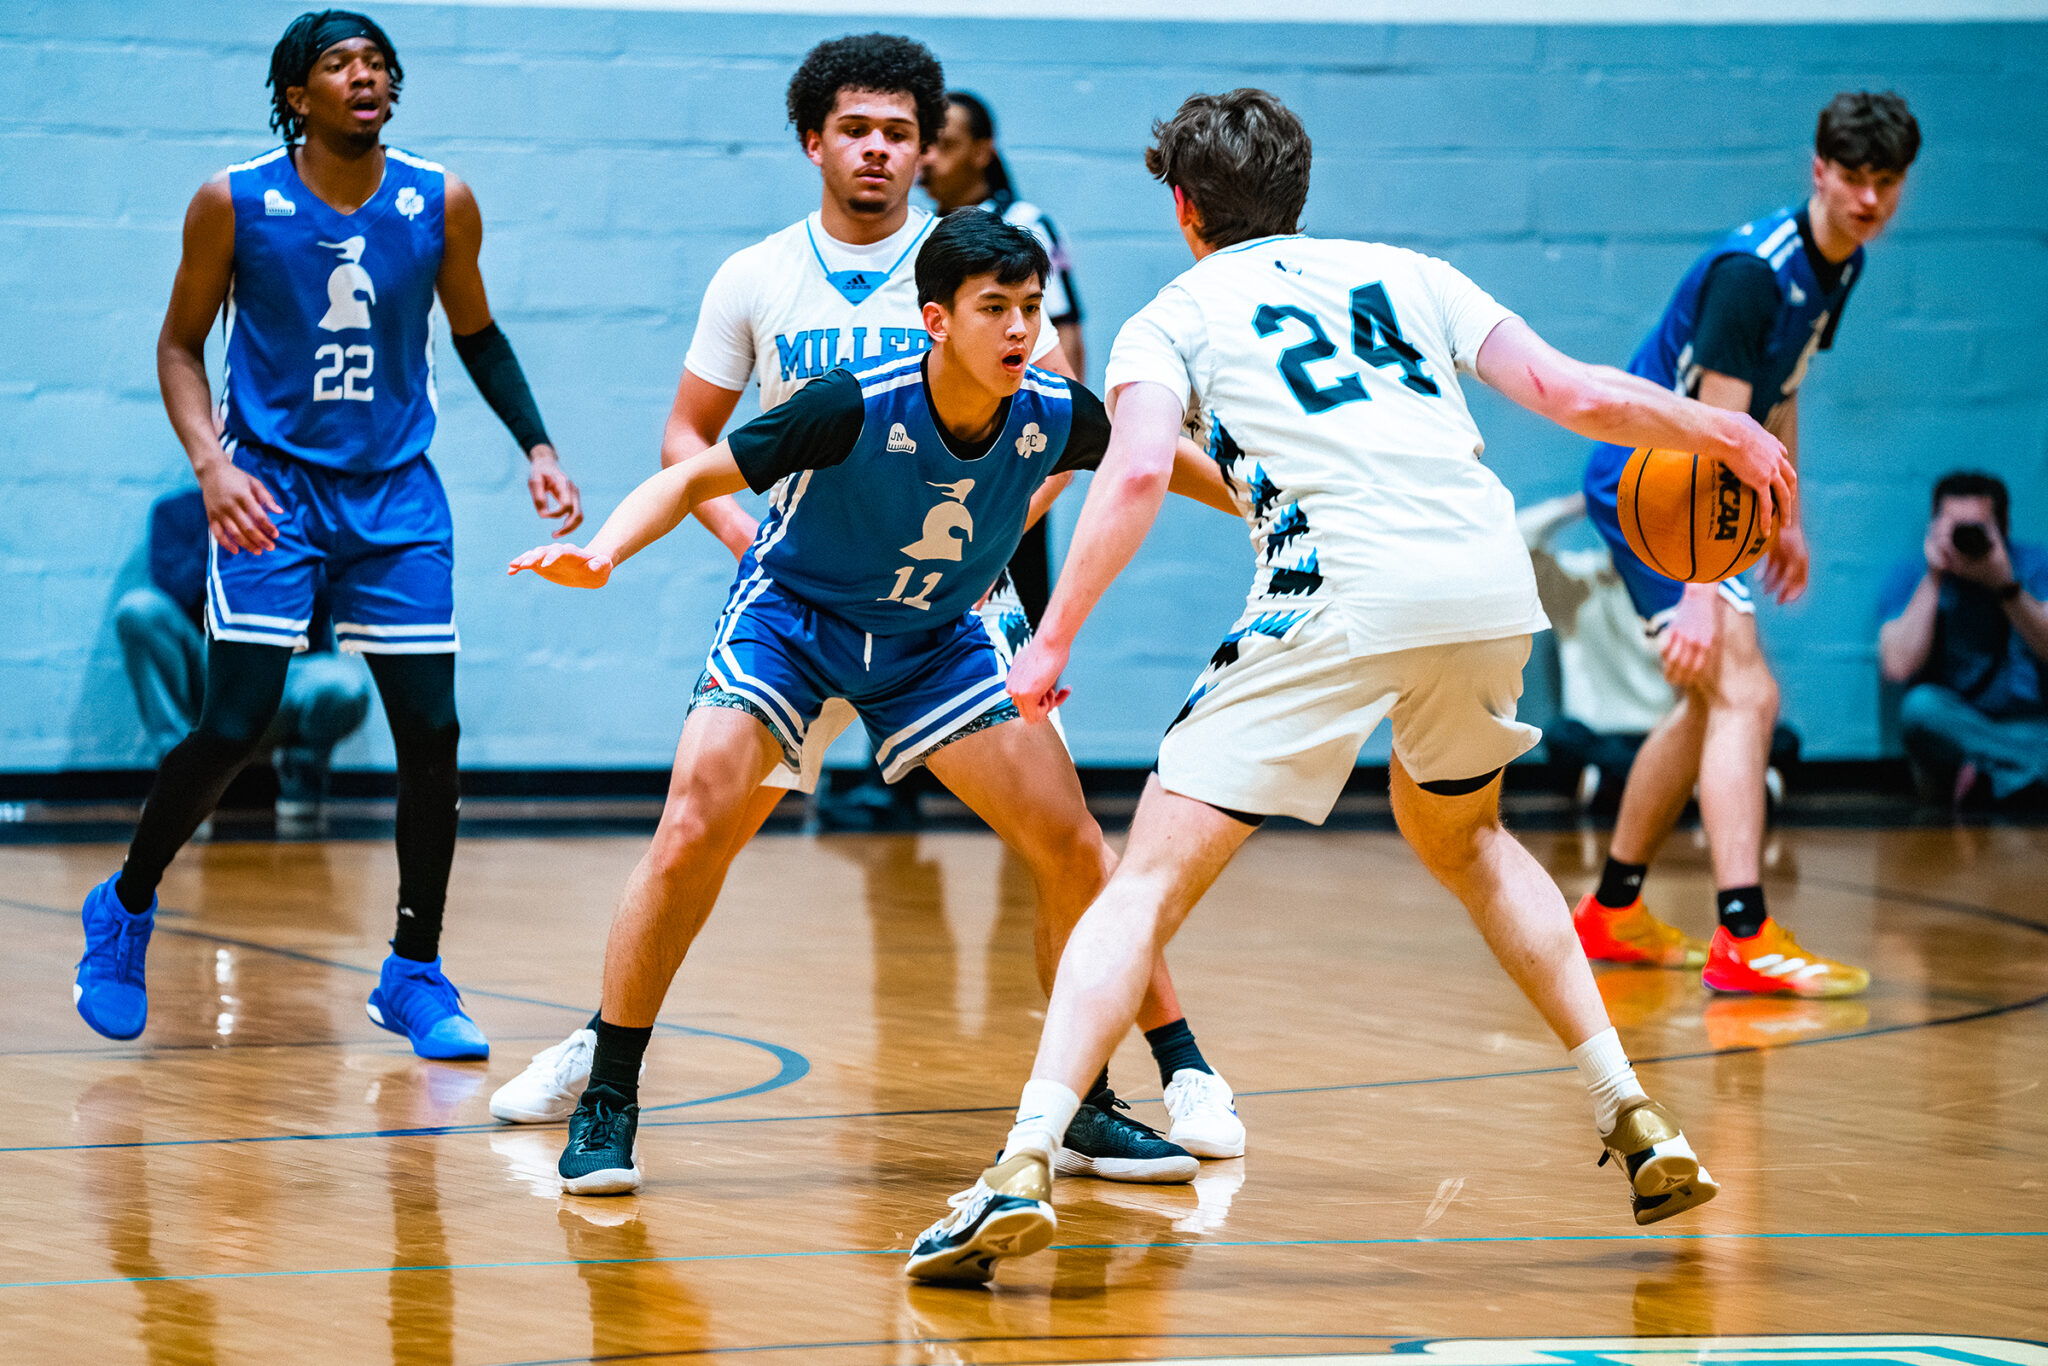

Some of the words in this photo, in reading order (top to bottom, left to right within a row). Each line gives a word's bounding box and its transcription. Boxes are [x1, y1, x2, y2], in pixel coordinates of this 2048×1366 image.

[313, 343, 375, 402] 22
[1251, 280, 1441, 416] 24
[876, 566, 943, 611] 11
